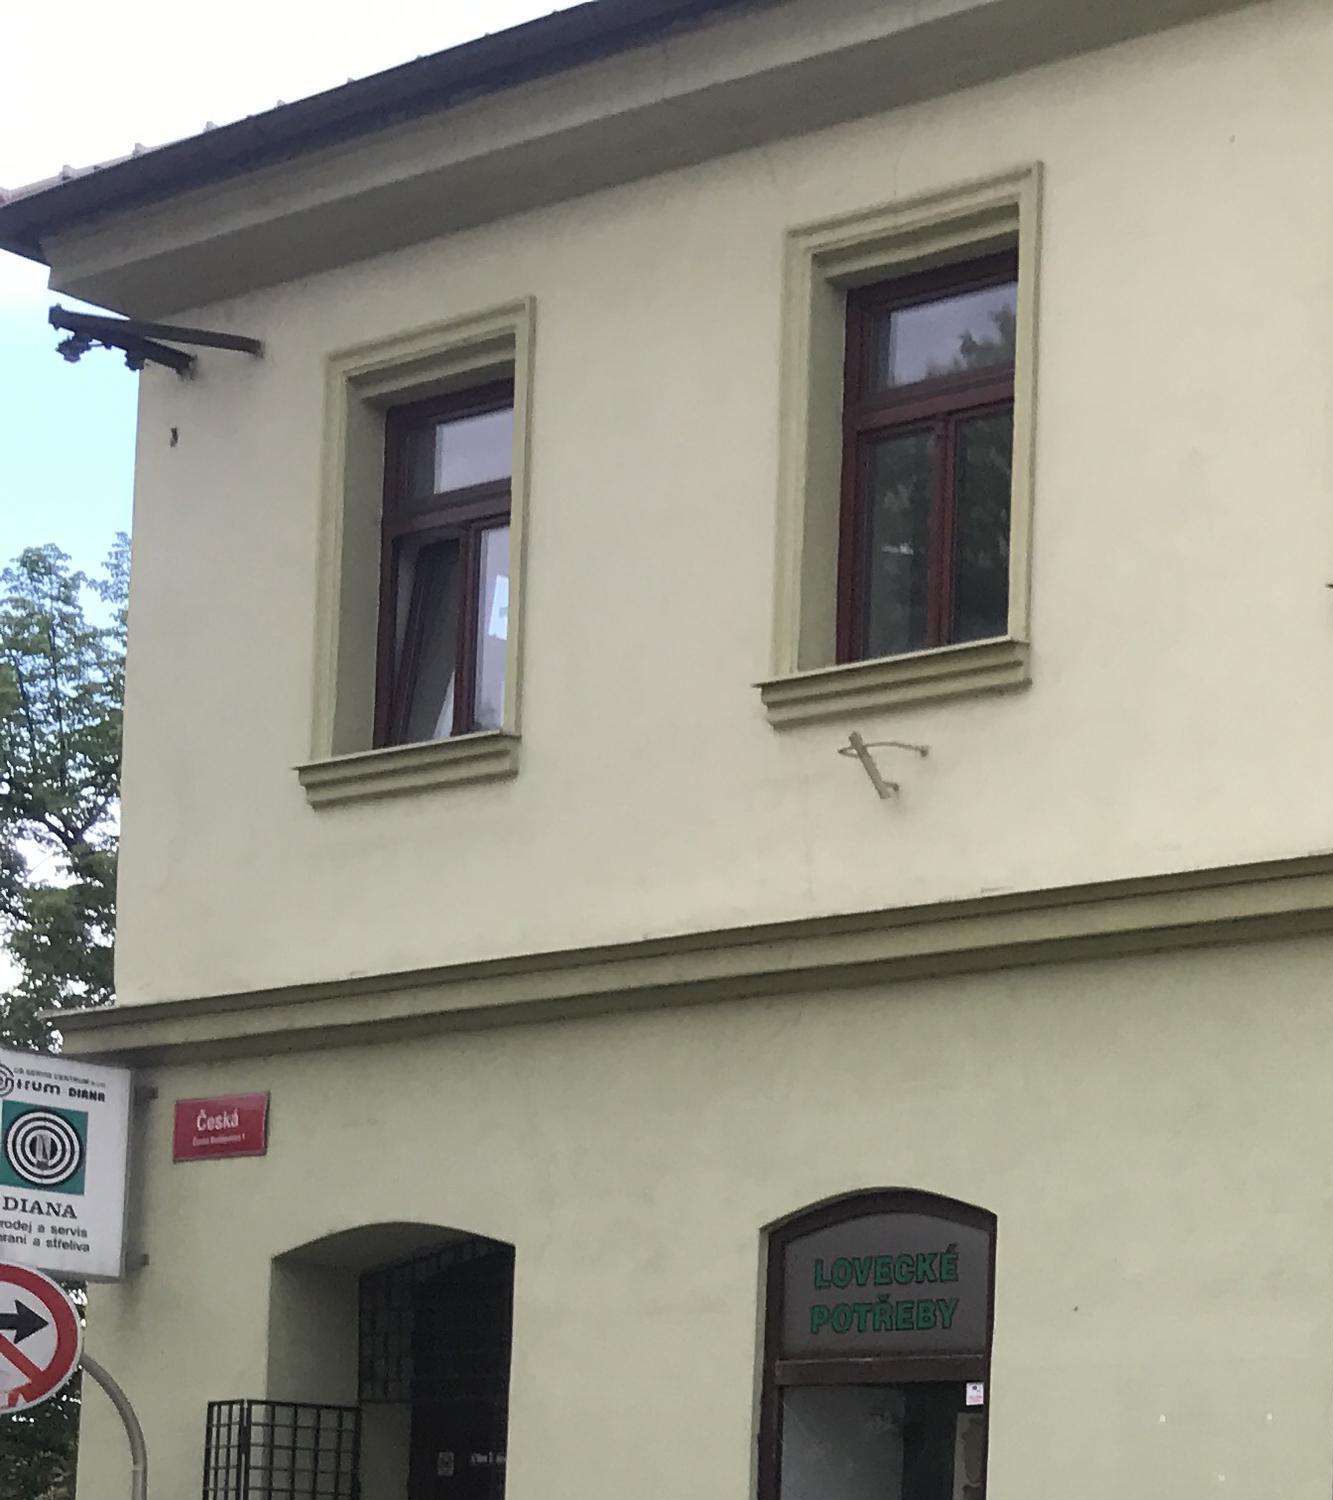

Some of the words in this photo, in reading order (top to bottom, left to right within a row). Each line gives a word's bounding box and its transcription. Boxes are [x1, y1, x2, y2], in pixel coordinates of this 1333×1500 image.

[69, 1087, 105, 1102] DIANA
[196, 1108, 239, 1131] Česká
[2, 1196, 77, 1220] DIANA
[0, 1220, 31, 1234] rodej
[38, 1224, 45, 1233] a
[51, 1225, 87, 1238] servis
[33, 1237, 40, 1246] a
[814, 1242, 959, 1290] LOVECKÉ
[810, 1293, 960, 1335] POTŘEBY
